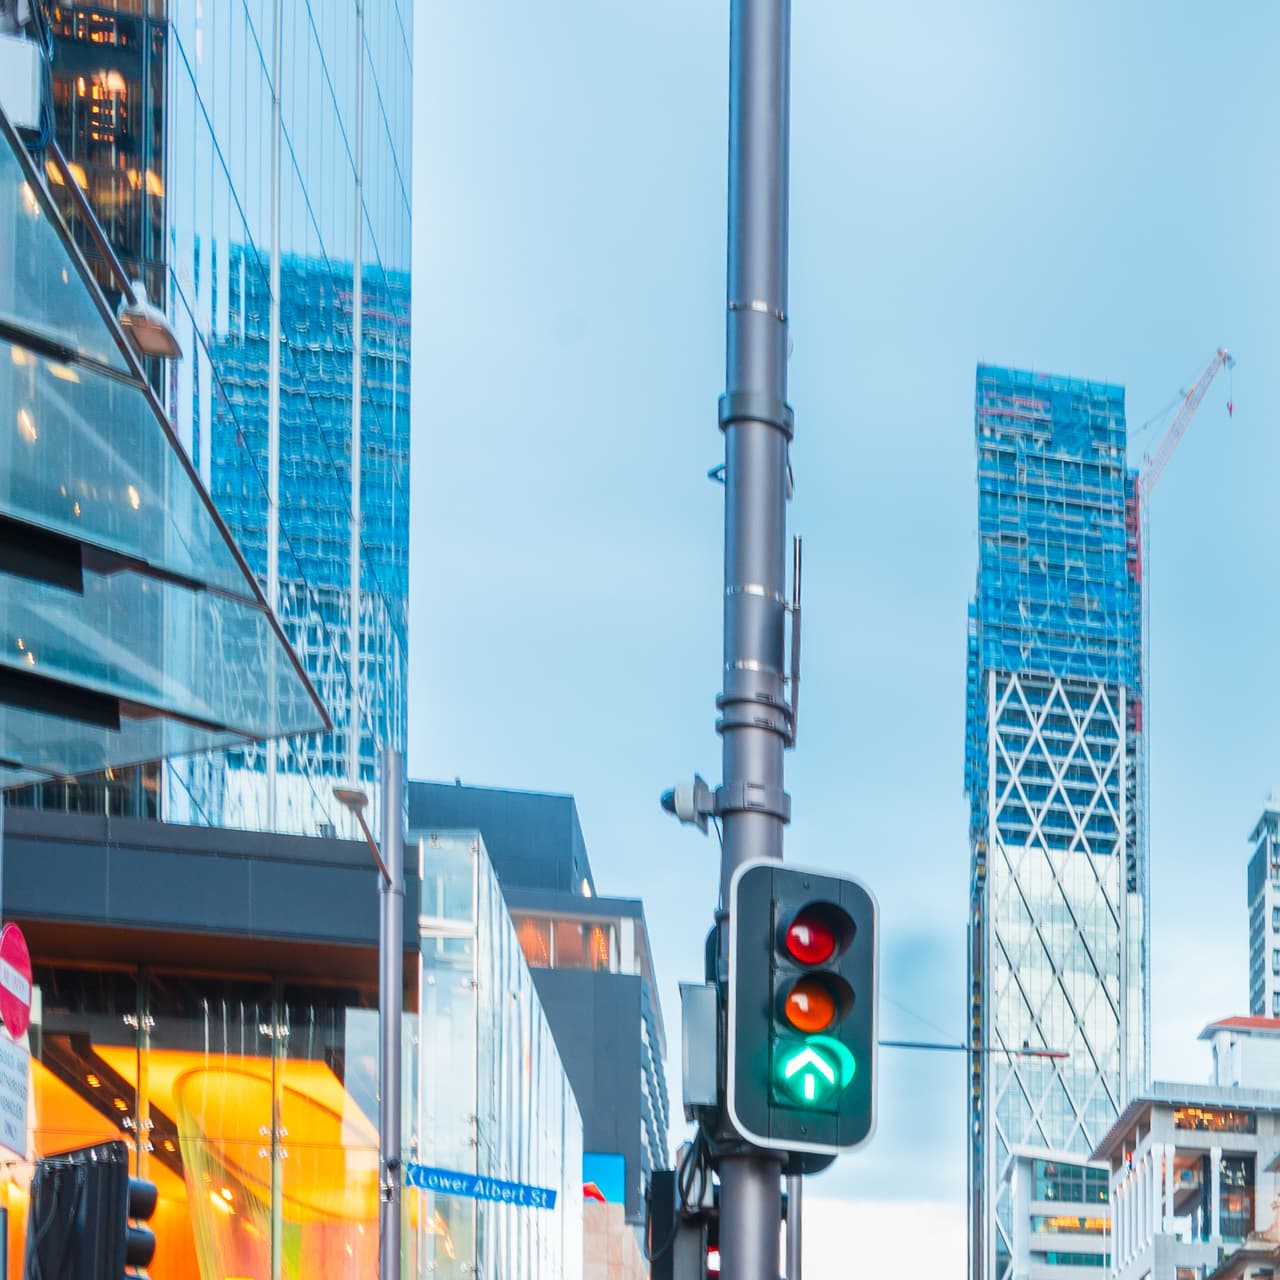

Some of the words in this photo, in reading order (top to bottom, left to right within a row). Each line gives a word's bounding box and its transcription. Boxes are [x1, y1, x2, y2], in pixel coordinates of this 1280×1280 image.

[420, 1168, 467, 1192] Lower
[473, 1179, 524, 1203] Albert
[530, 1189, 547, 1206] St
